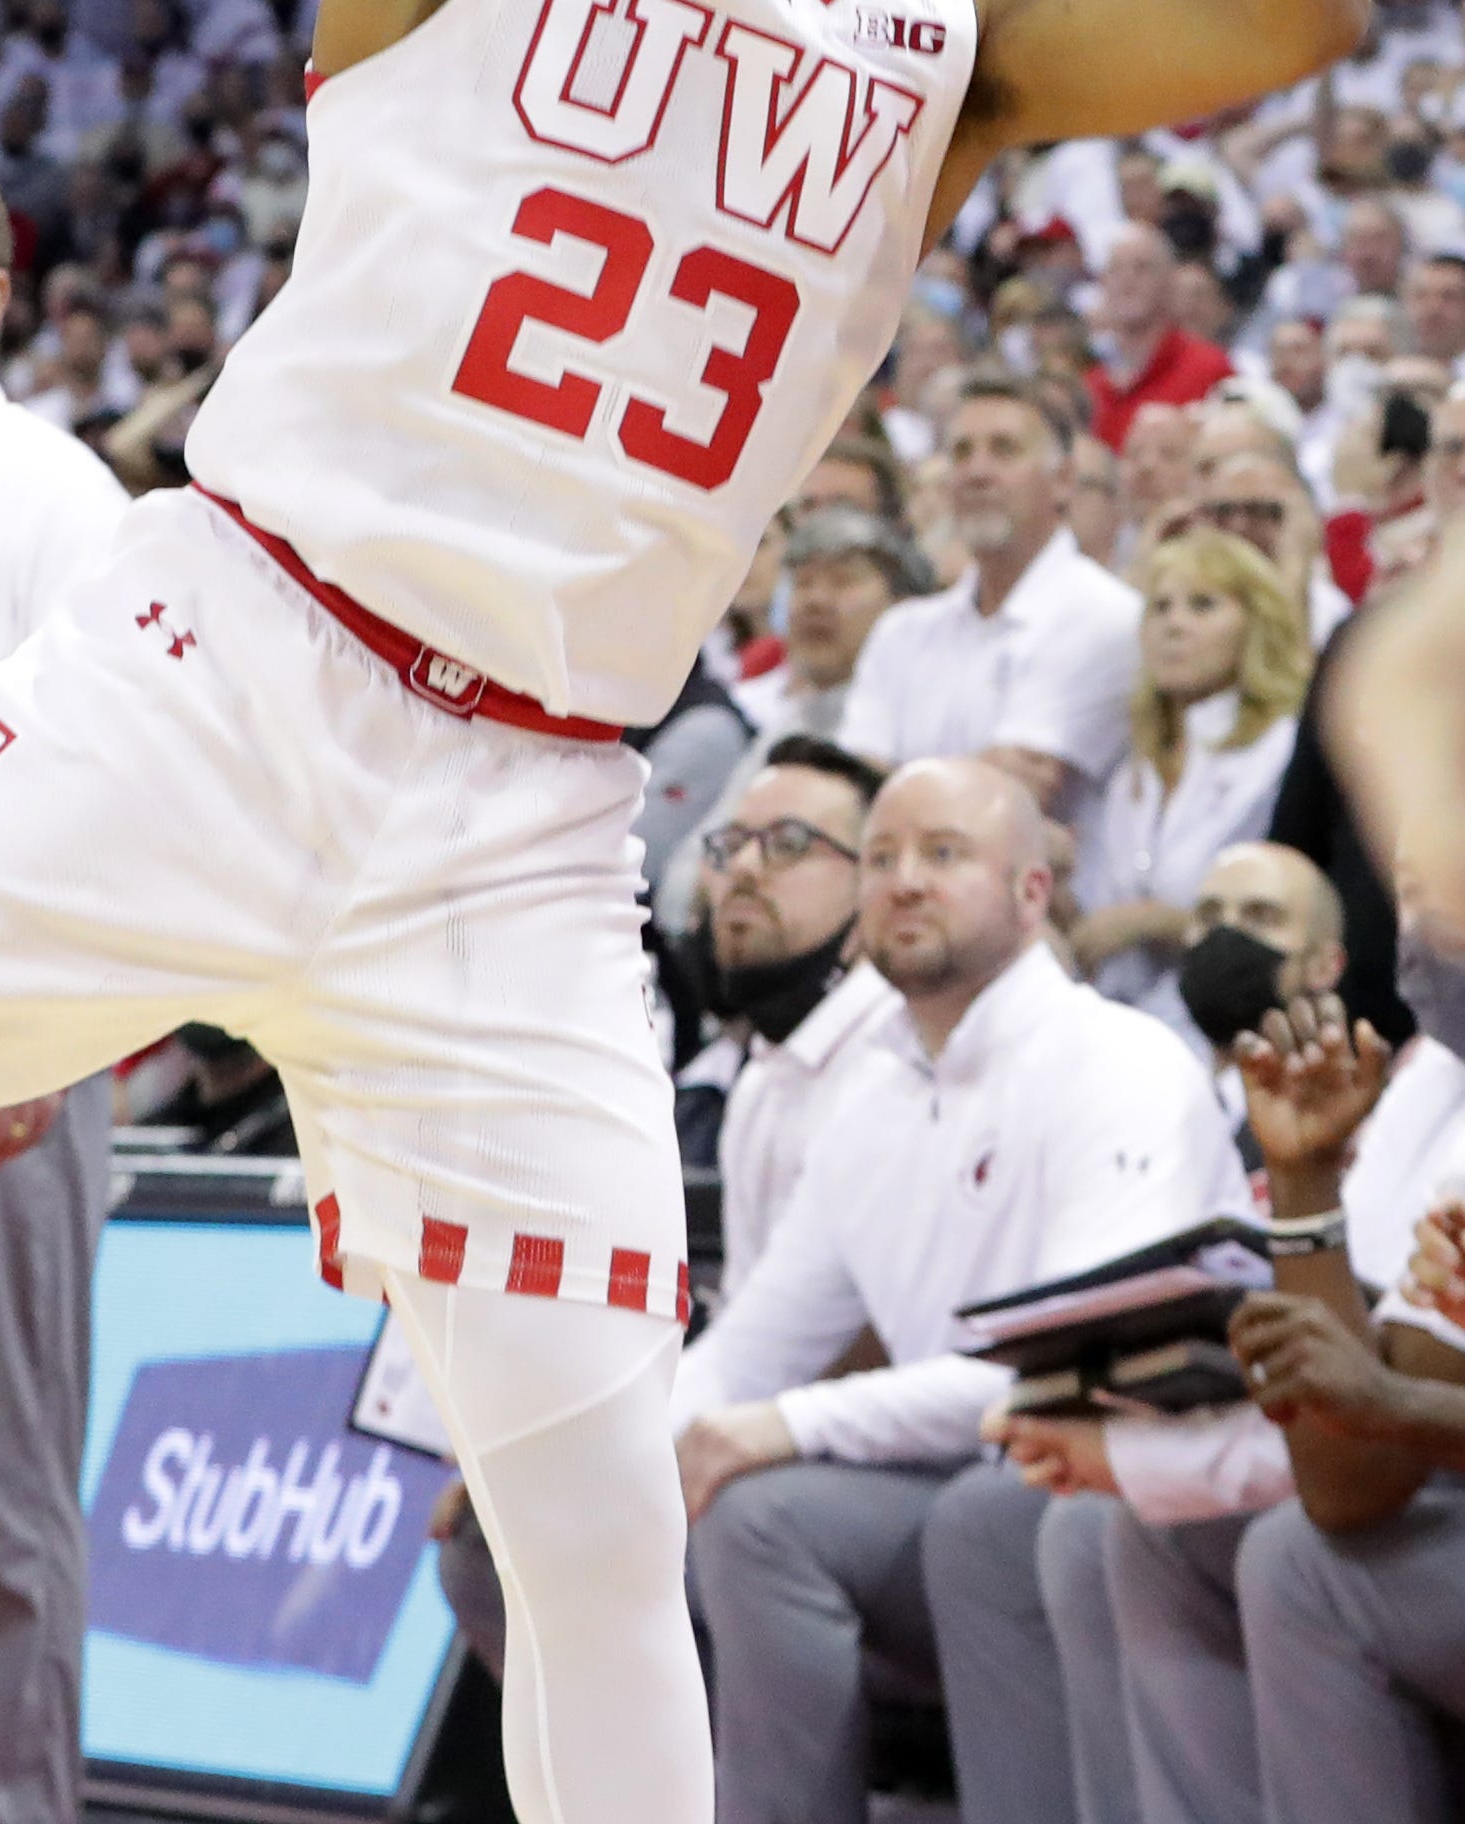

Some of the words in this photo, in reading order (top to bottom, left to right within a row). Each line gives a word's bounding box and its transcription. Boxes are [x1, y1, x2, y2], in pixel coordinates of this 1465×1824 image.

[450, 185, 802, 493] 23
[426, 653, 480, 698] W
[121, 1424, 403, 1570] StubHub
